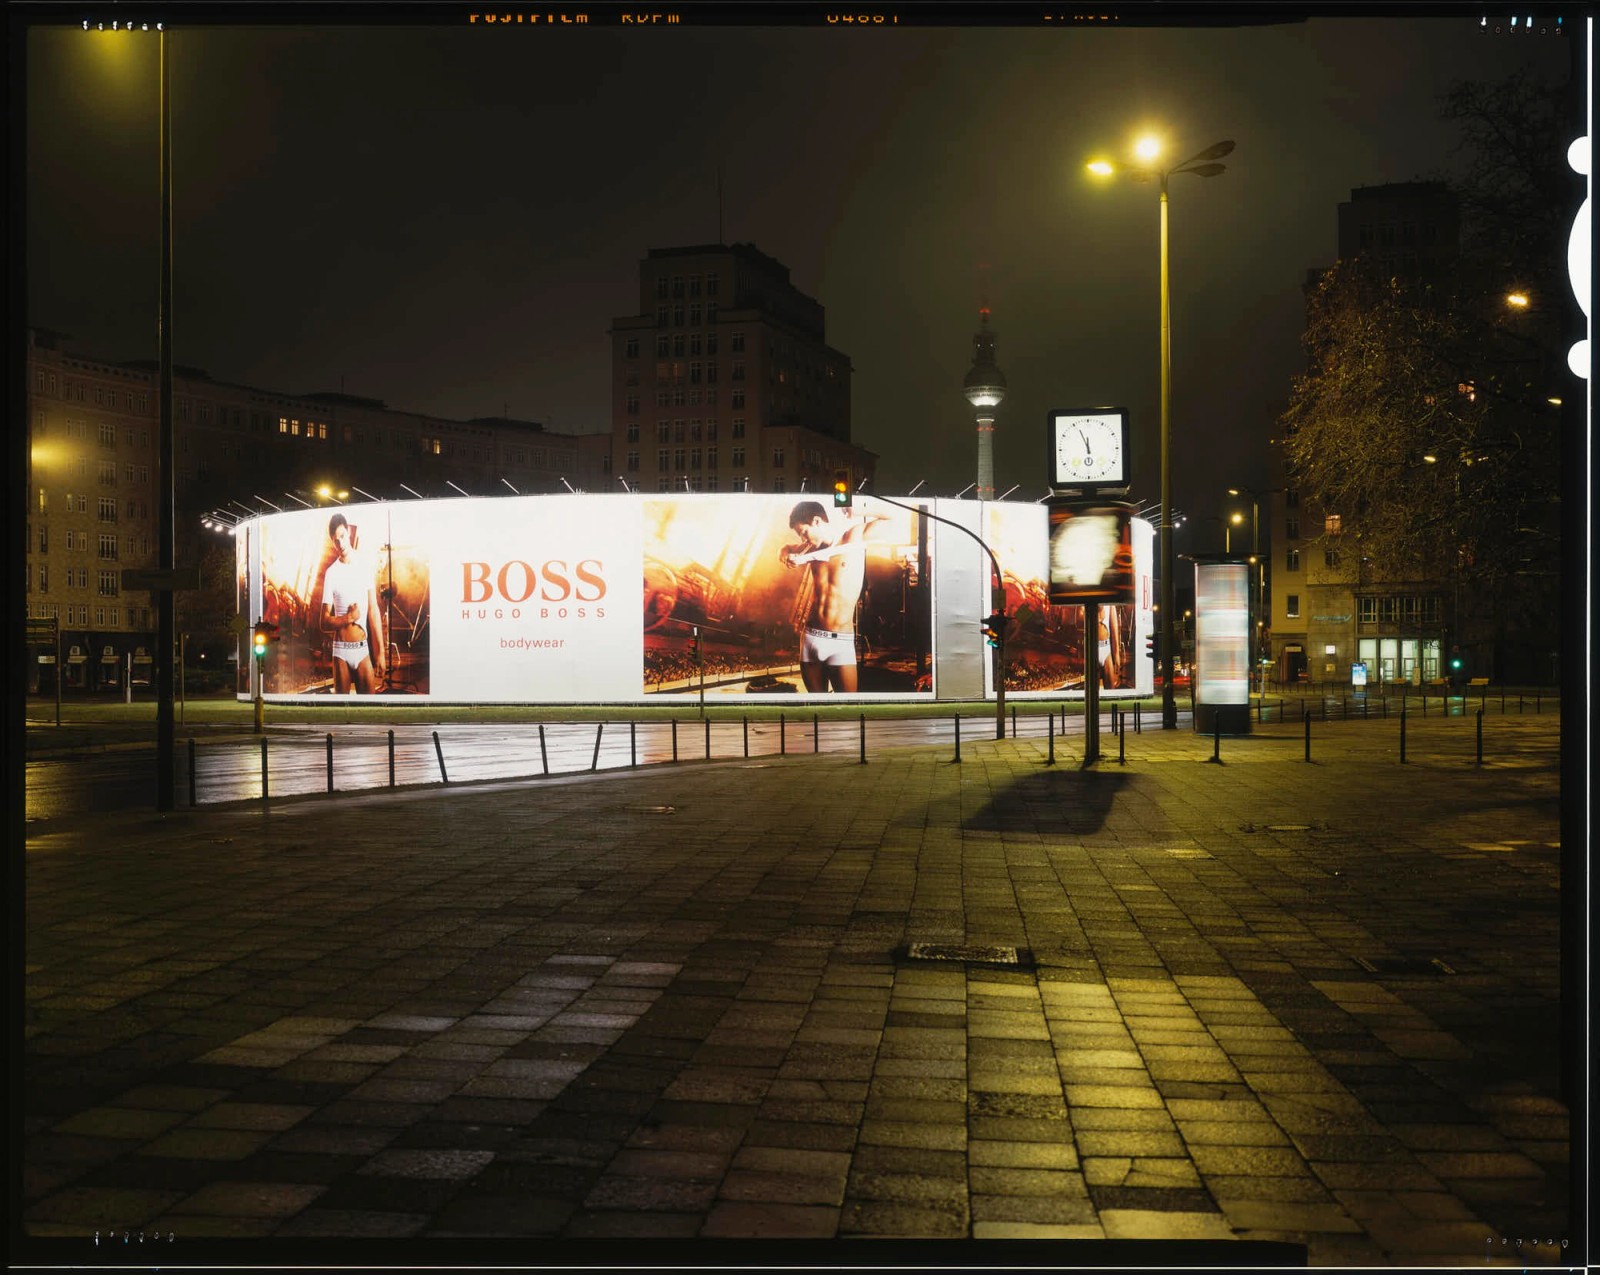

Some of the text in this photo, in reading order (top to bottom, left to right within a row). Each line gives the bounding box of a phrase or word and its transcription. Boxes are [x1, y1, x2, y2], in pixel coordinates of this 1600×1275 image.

[461, 559, 607, 603] BOSS
[462, 608, 606, 620] HUGO BOSS
[500, 637, 565, 650] bodywear
